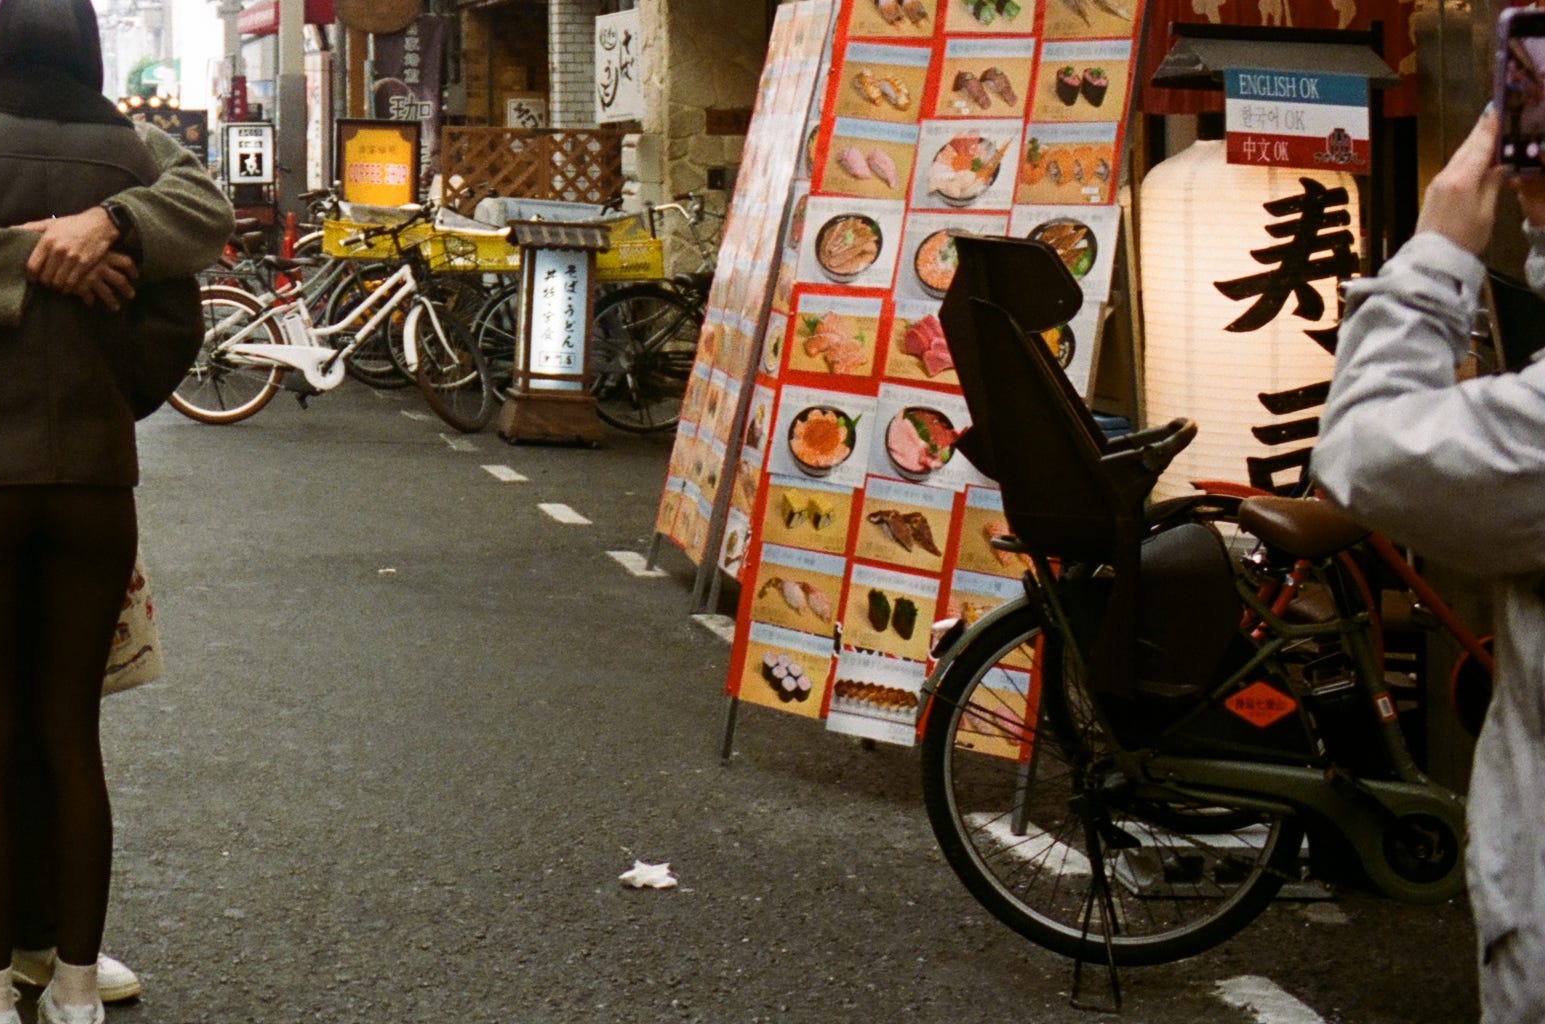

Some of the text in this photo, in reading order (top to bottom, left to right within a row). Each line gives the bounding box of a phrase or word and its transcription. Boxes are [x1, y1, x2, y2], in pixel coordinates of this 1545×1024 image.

[1239, 74, 1320, 99] ENGLISH OK
[1241, 104, 1305, 131] 한국어 OK
[1243, 136, 1271, 162] 中文
[1273, 140, 1290, 161] OK
[562, 264, 578, 349] そば・うどん
